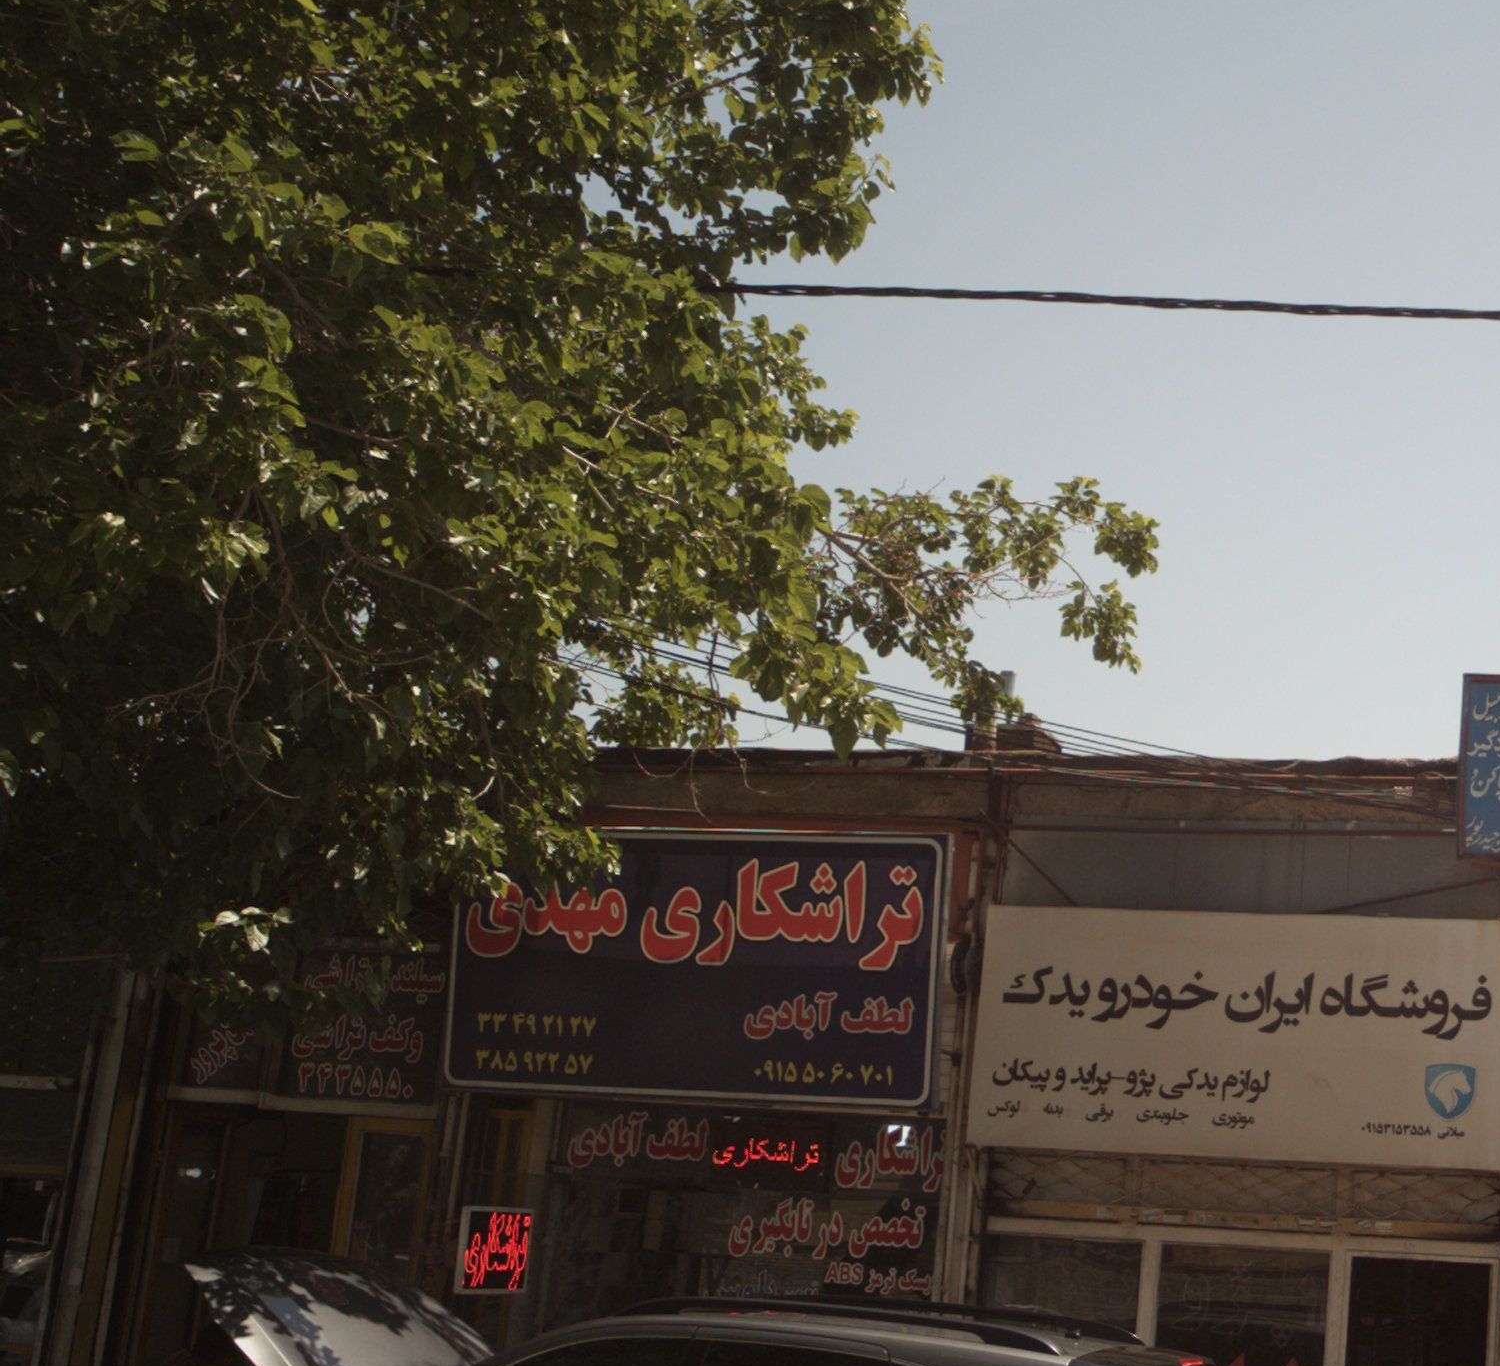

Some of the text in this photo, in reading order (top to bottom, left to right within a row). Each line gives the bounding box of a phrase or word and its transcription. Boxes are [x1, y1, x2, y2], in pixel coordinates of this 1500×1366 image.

[464, 858, 924, 972] تراشکاری مهدی
[744, 990, 915, 1040] لطف آبادی
[1224, 971, 1316, 1033] ایران
[1319, 973, 1493, 1040] فروشگاه
[299, 1062, 414, 1099] ۳۴۳۵۵۵۰
[992, 1058, 1051, 1094] پیکان
[1221, 1068, 1271, 1103] لوازم
[1136, 1107, 1189, 1125] جلوبندی
[569, 1111, 710, 1168] لطف آبادی
[711, 1137, 820, 1171] تراشکاری
[848, 1198, 927, 1259] تخصص
[824, 1262, 864, 1285] ABS
